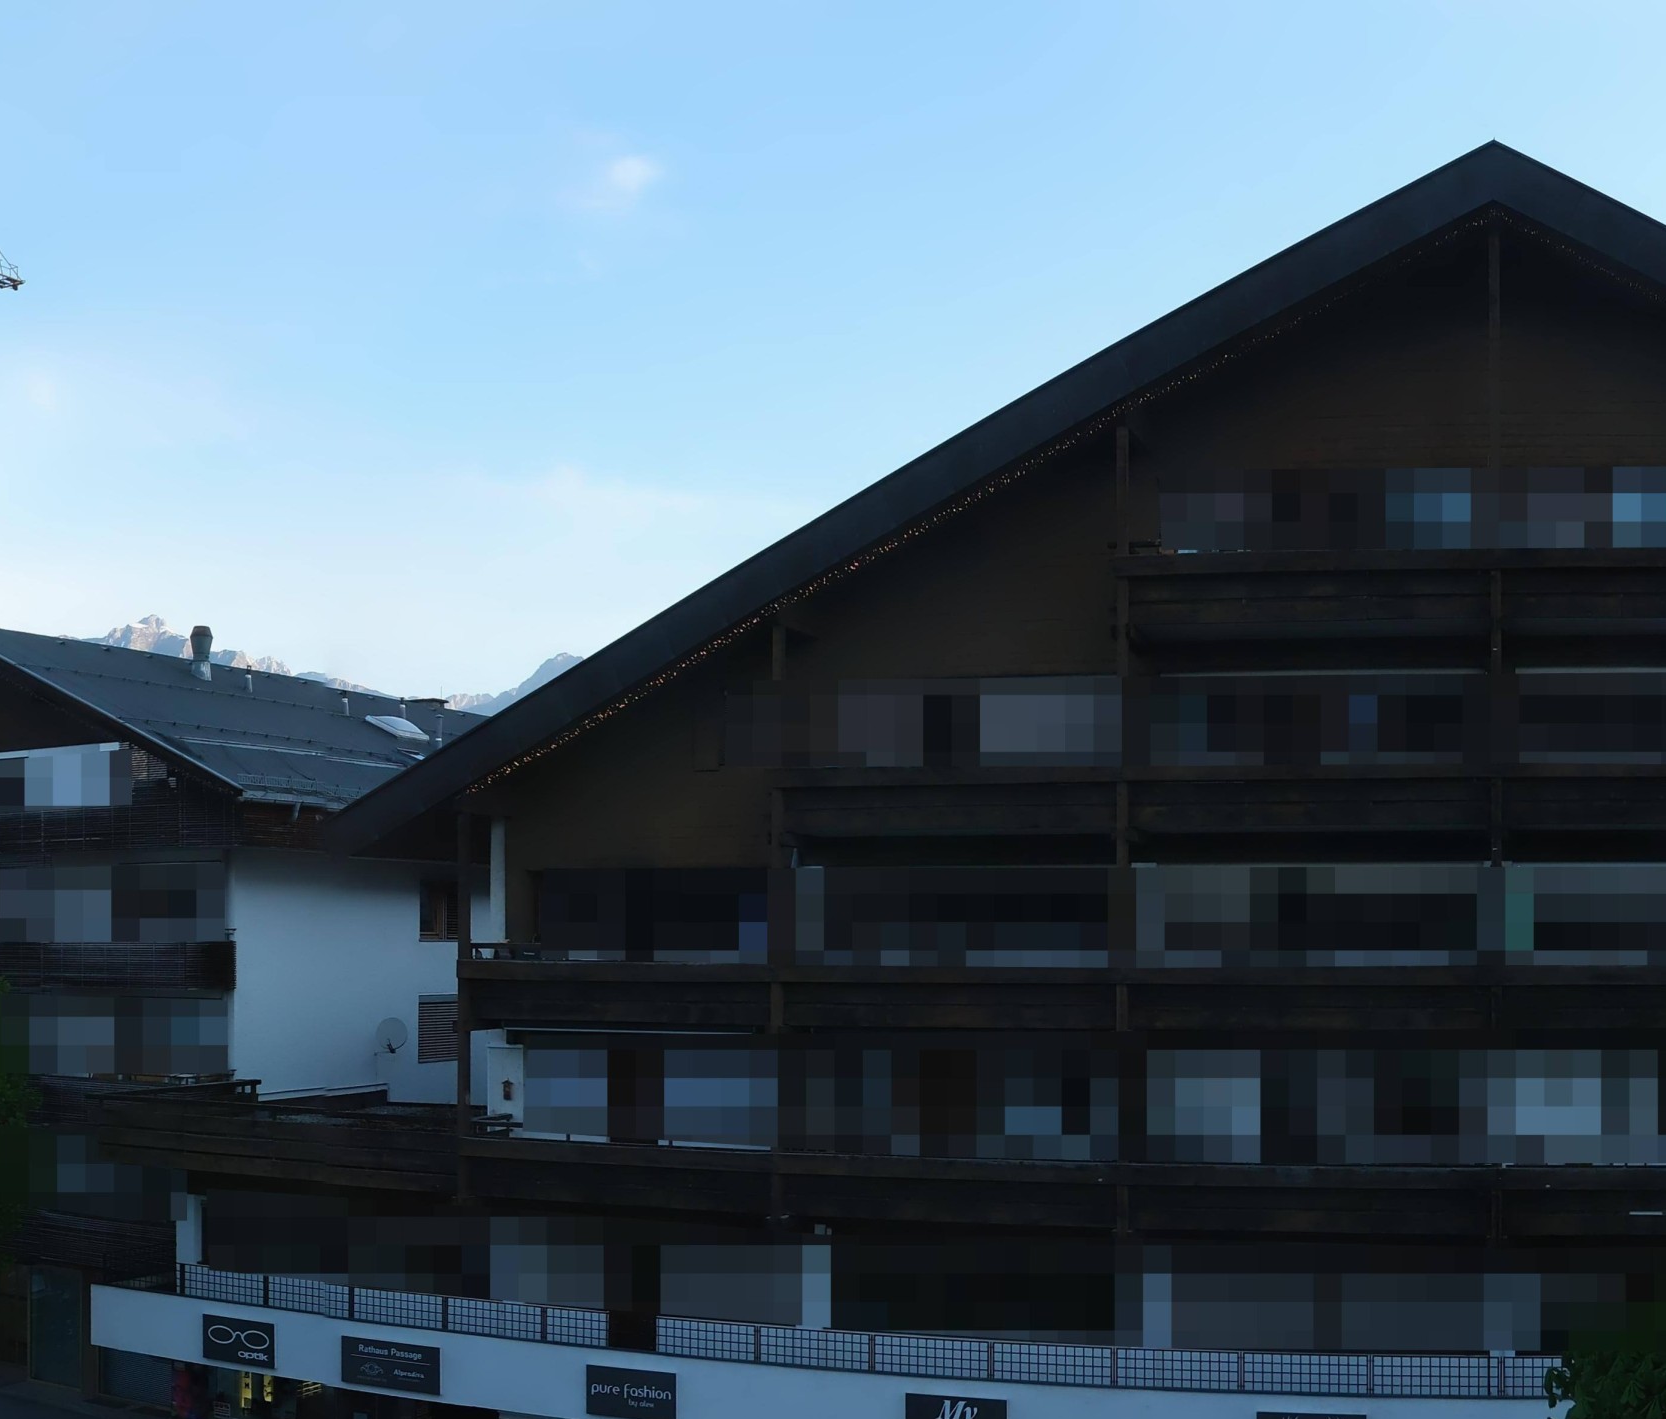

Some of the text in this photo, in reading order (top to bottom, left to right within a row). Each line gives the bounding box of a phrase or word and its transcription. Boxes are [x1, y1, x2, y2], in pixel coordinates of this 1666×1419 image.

[237, 1350, 269, 1362] optik
[358, 1343, 423, 1361] Rathaus Passage
[590, 1383, 672, 1401] pure fashion
